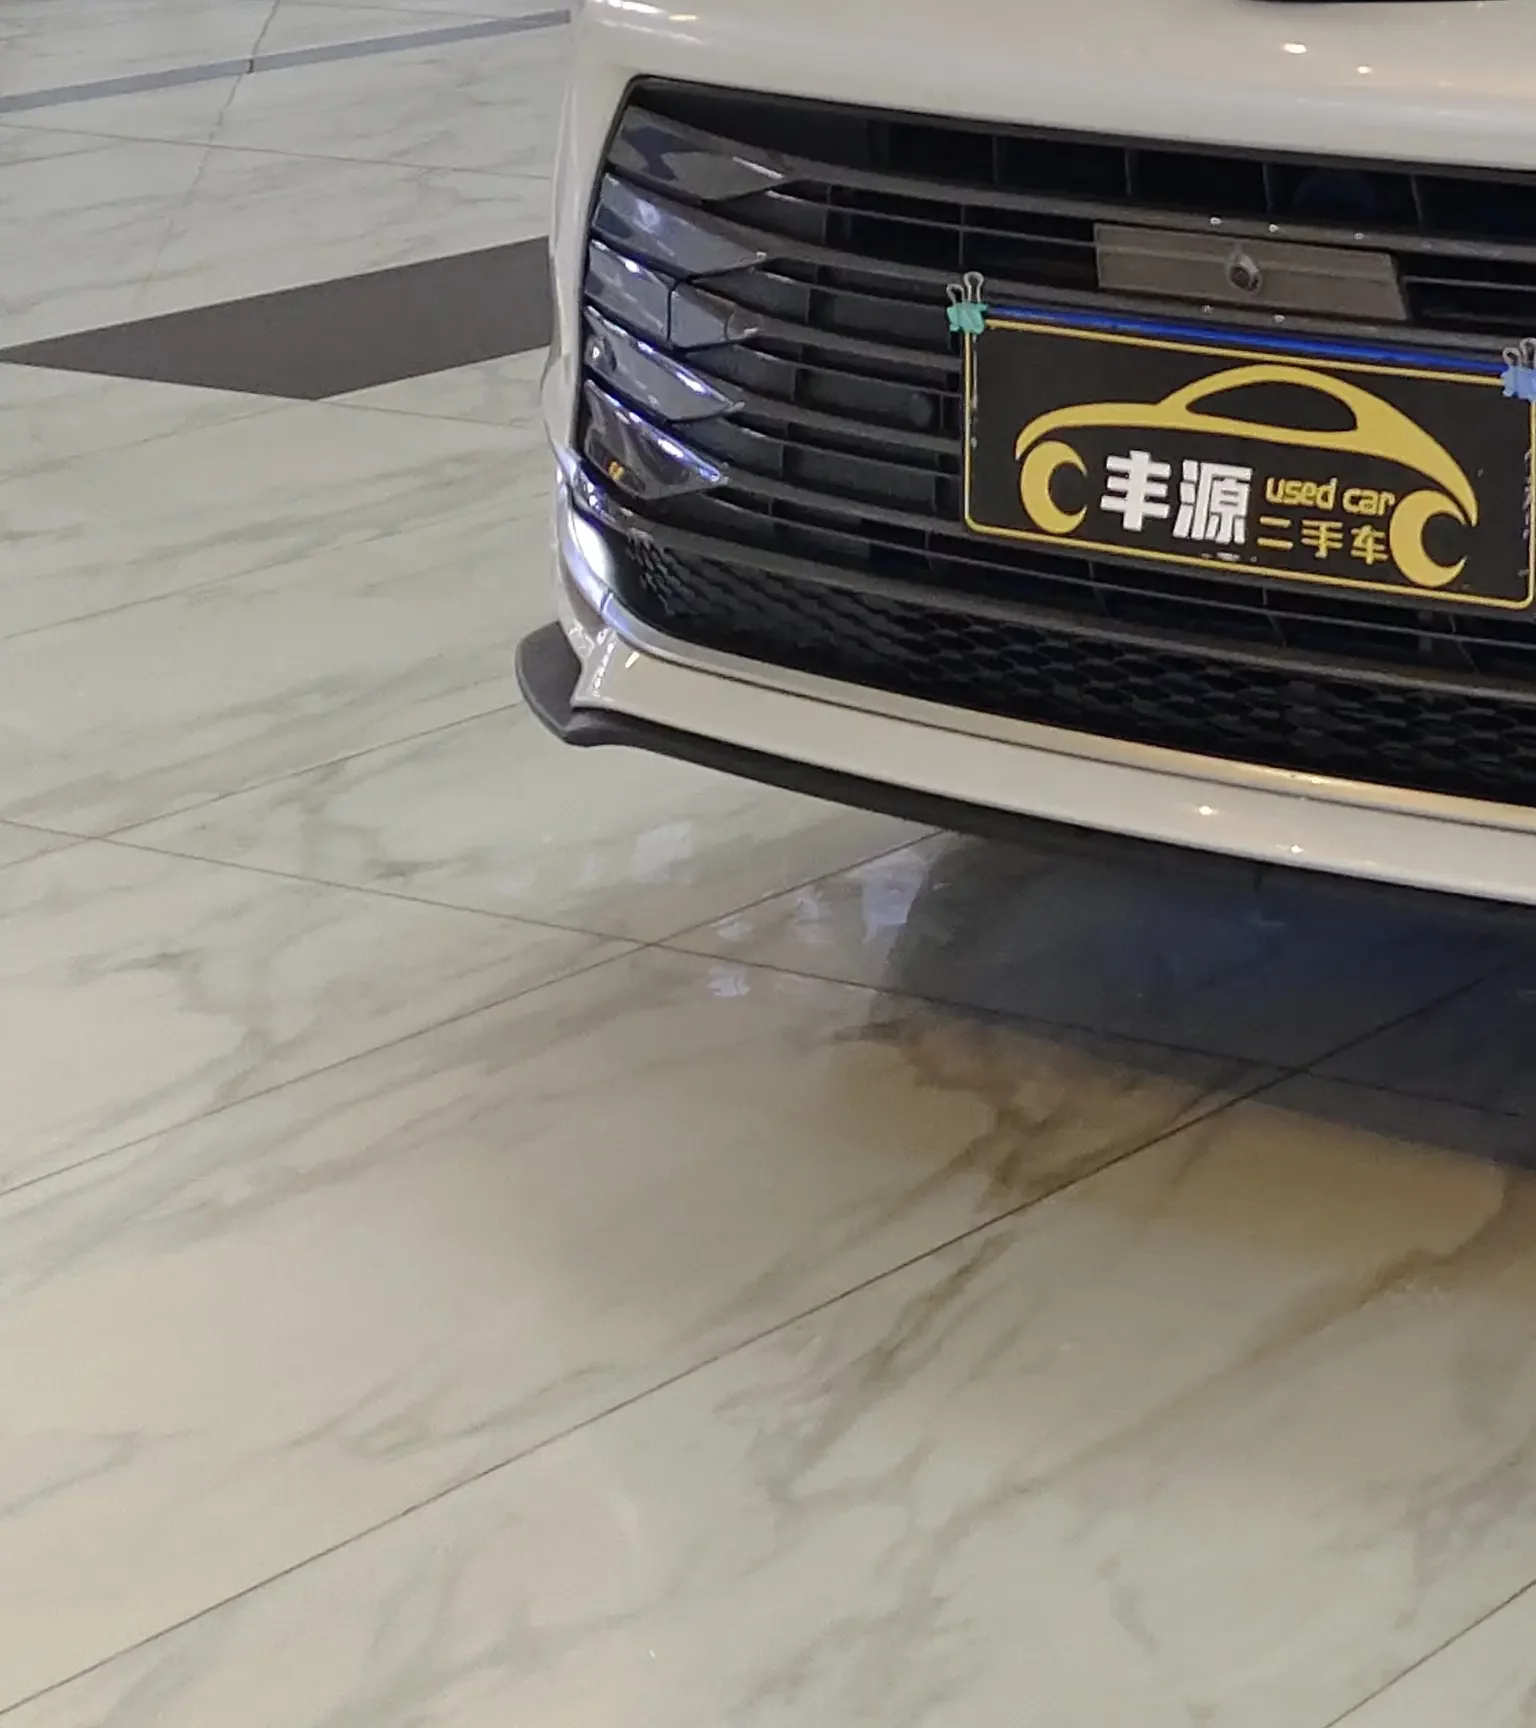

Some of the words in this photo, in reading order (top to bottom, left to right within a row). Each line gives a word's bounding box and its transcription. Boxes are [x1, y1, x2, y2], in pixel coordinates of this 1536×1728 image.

[1100, 450, 1254, 544] 丰源
[1265, 477, 1339, 511] used
[1342, 486, 1396, 516] car
[1256, 516, 1390, 565] 二手车
